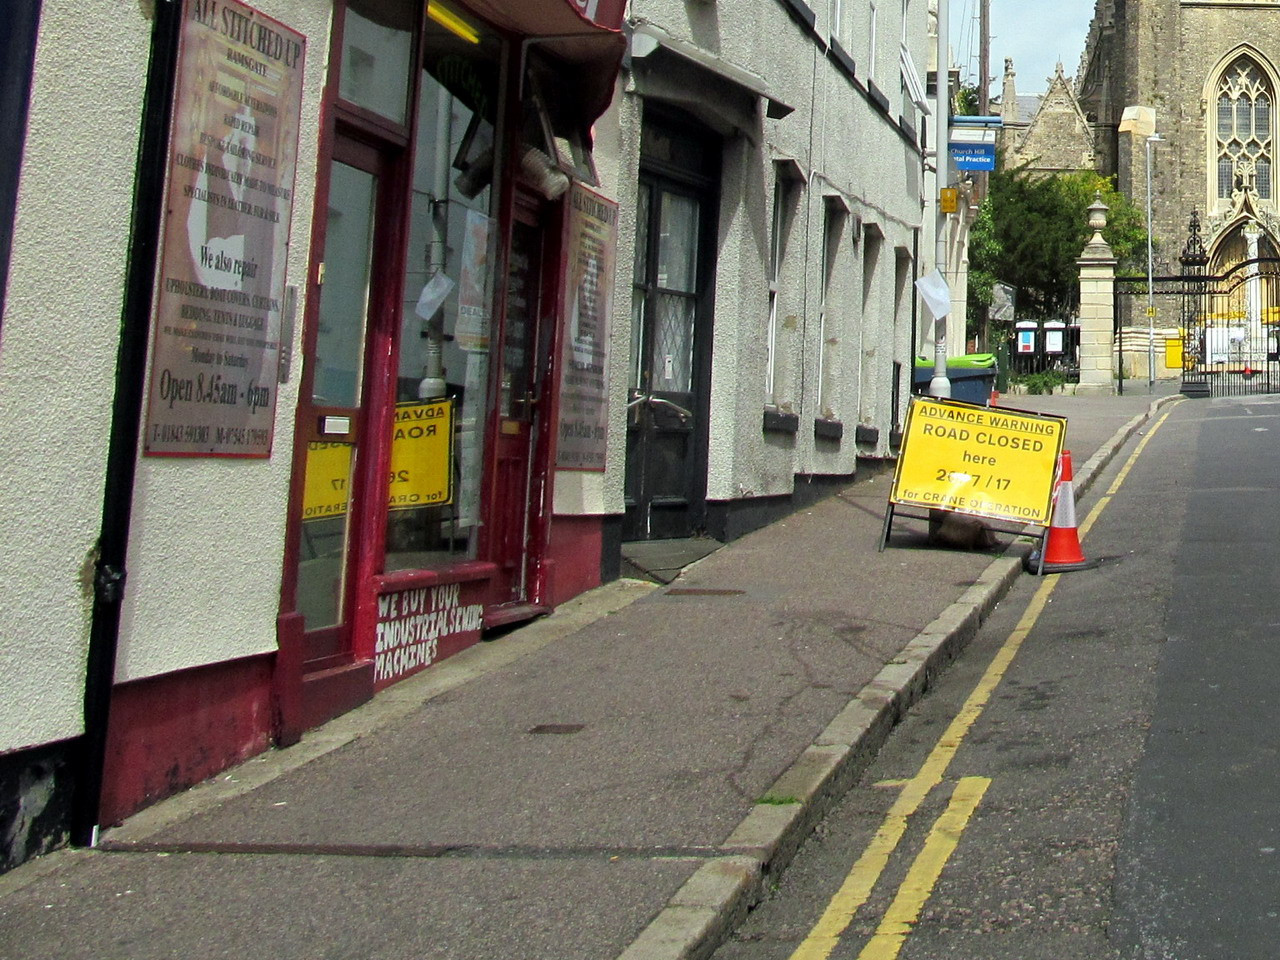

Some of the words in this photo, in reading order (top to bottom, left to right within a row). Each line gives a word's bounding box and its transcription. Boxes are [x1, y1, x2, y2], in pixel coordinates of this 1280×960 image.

[221, 6, 282, 61] STITCHED
[286, 39, 300, 69] UP
[228, 48, 267, 76] RAMSGATE
[966, 155, 991, 163] Practice
[200, 246, 213, 267] We
[216, 250, 231, 270] also
[234, 255, 257, 282] repair
[160, 369, 193, 408] Open
[197, 373, 237, 403] 8.45am
[248, 379, 269, 413] 6pm
[918, 405, 984, 425] ADVANCE
[989, 415, 1055, 436] WARNING
[923, 423, 970, 442] ROAD
[976, 431, 1044, 453] CLOSED
[962, 450, 997, 467] here
[903, 489, 919, 500] for
[923, 492, 966, 507] CRANE
[378, 592, 399, 618] WE
[402, 587, 427, 616] BUY
[431, 582, 460, 613] YOUR
[375, 610, 449, 653] INDUSTRIAL
[449, 604, 484, 632] SEWING
[374, 638, 439, 685] MACHINES
